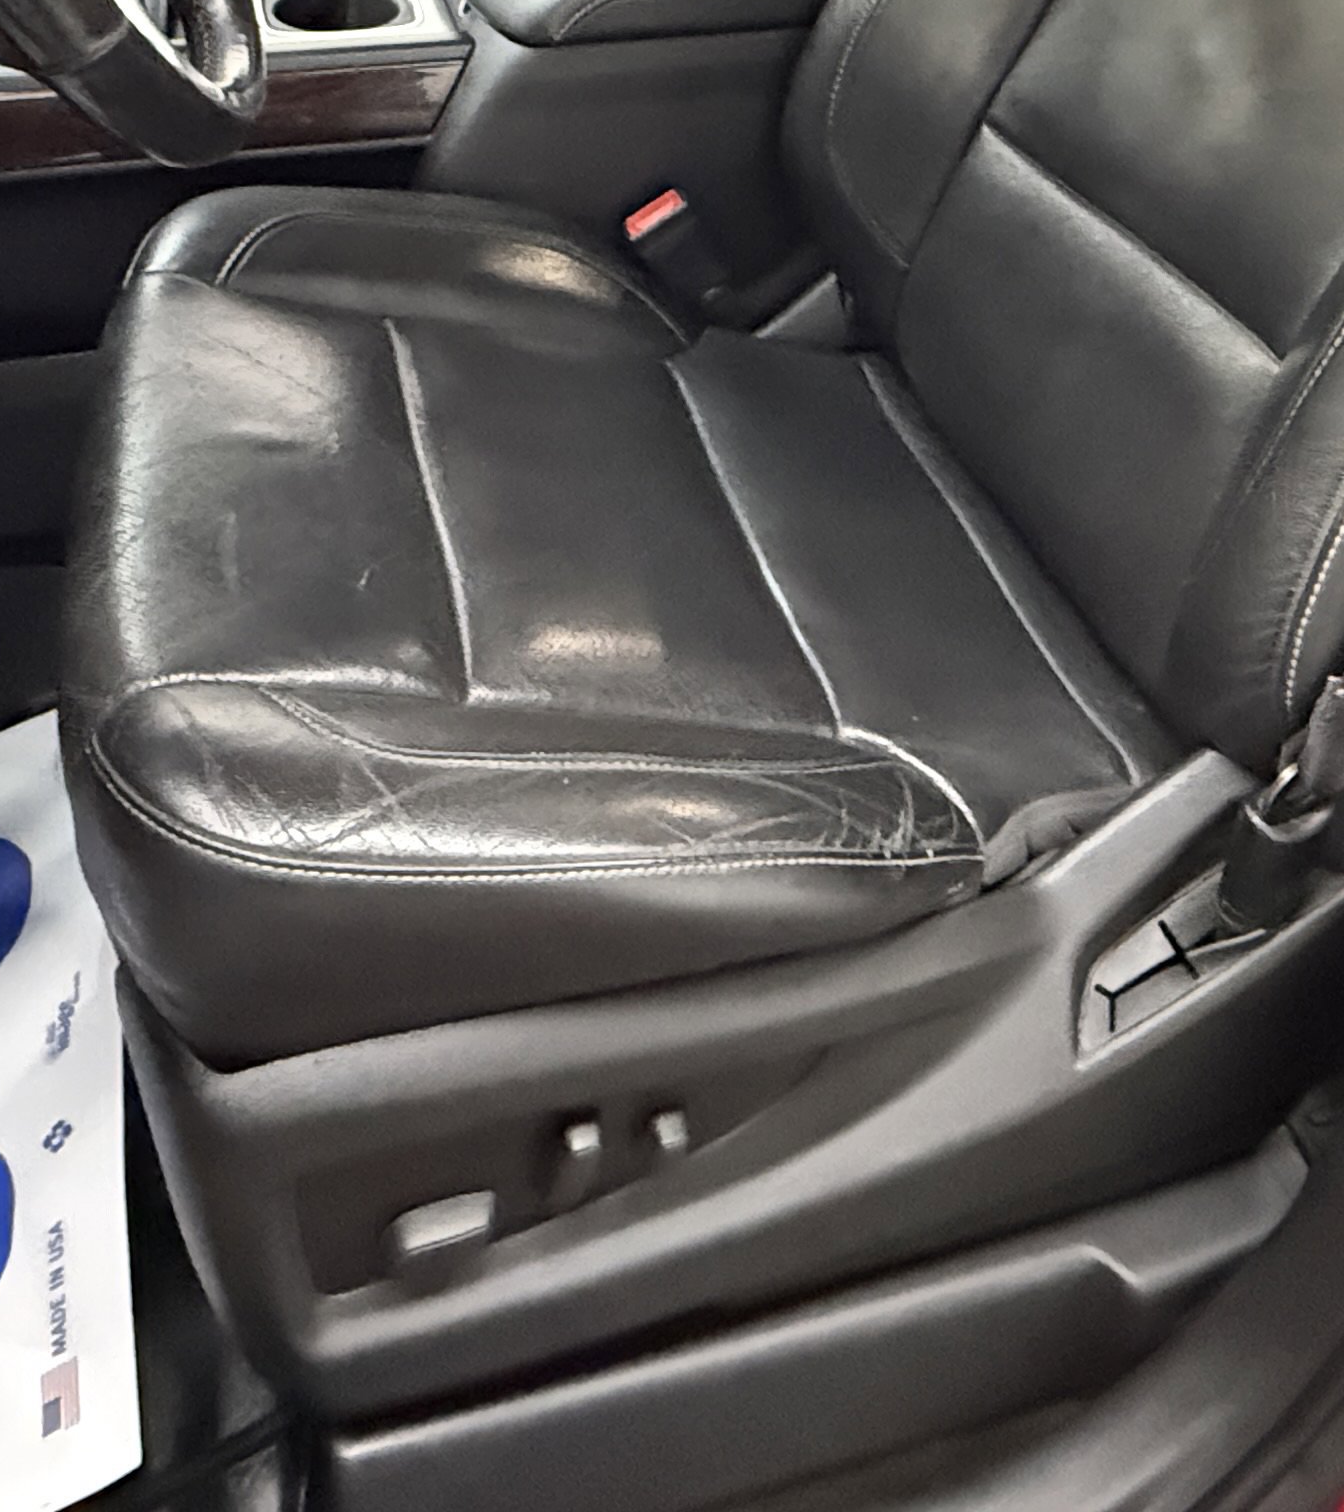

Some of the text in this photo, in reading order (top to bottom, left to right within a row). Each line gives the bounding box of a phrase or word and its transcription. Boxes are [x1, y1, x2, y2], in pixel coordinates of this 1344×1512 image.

[47, 1219, 67, 1357] MADE IN USA
